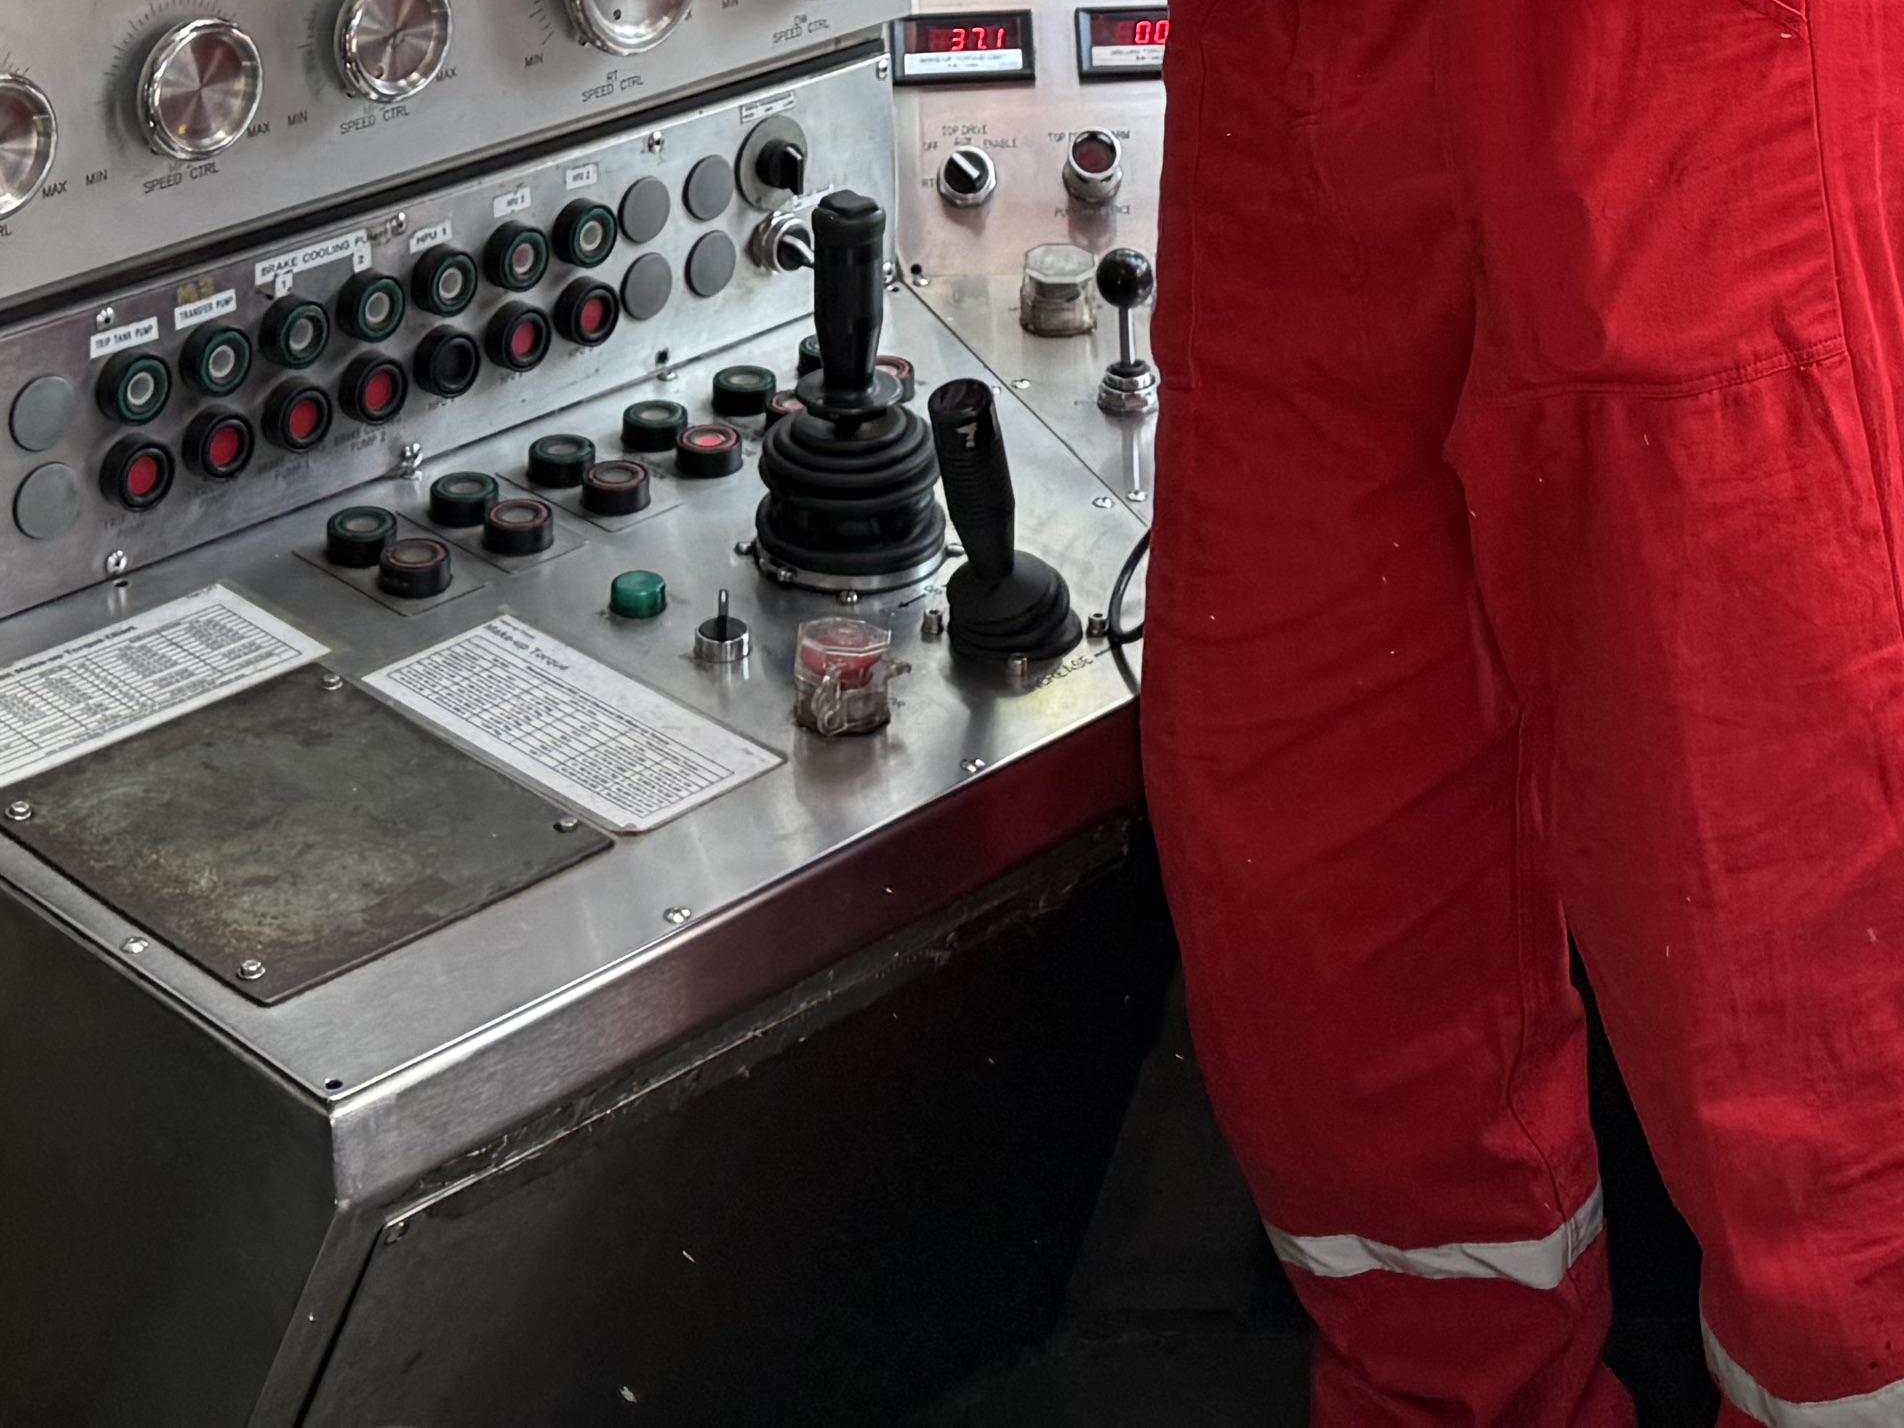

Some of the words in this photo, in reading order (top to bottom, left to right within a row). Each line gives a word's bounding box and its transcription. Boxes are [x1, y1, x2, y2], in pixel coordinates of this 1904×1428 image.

[772, 25, 805, 43] SPEED
[807, 18, 830, 36] CTRL
[581, 83, 614, 102] SPEED
[620, 75, 644, 92] CTRL
[340, 115, 376, 134] SPEED
[383, 104, 409, 122] CTRL
[85, 169, 108, 186] MIN
[248, 120, 270, 137] MAX
[42, 181, 67, 199] MAX
[144, 173, 182, 194] SPEED
[190, 162, 220, 181] CTRL
[261, 256, 297, 278] BRAKE
[301, 241, 350, 265] COOLING
[179, 302, 214, 322] TRANSFER
[217, 296, 234, 311] PUMP
[114, 330, 132, 345] TANK
[135, 324, 153, 339] PUMP
[530, 648, 569, 671] Torque
